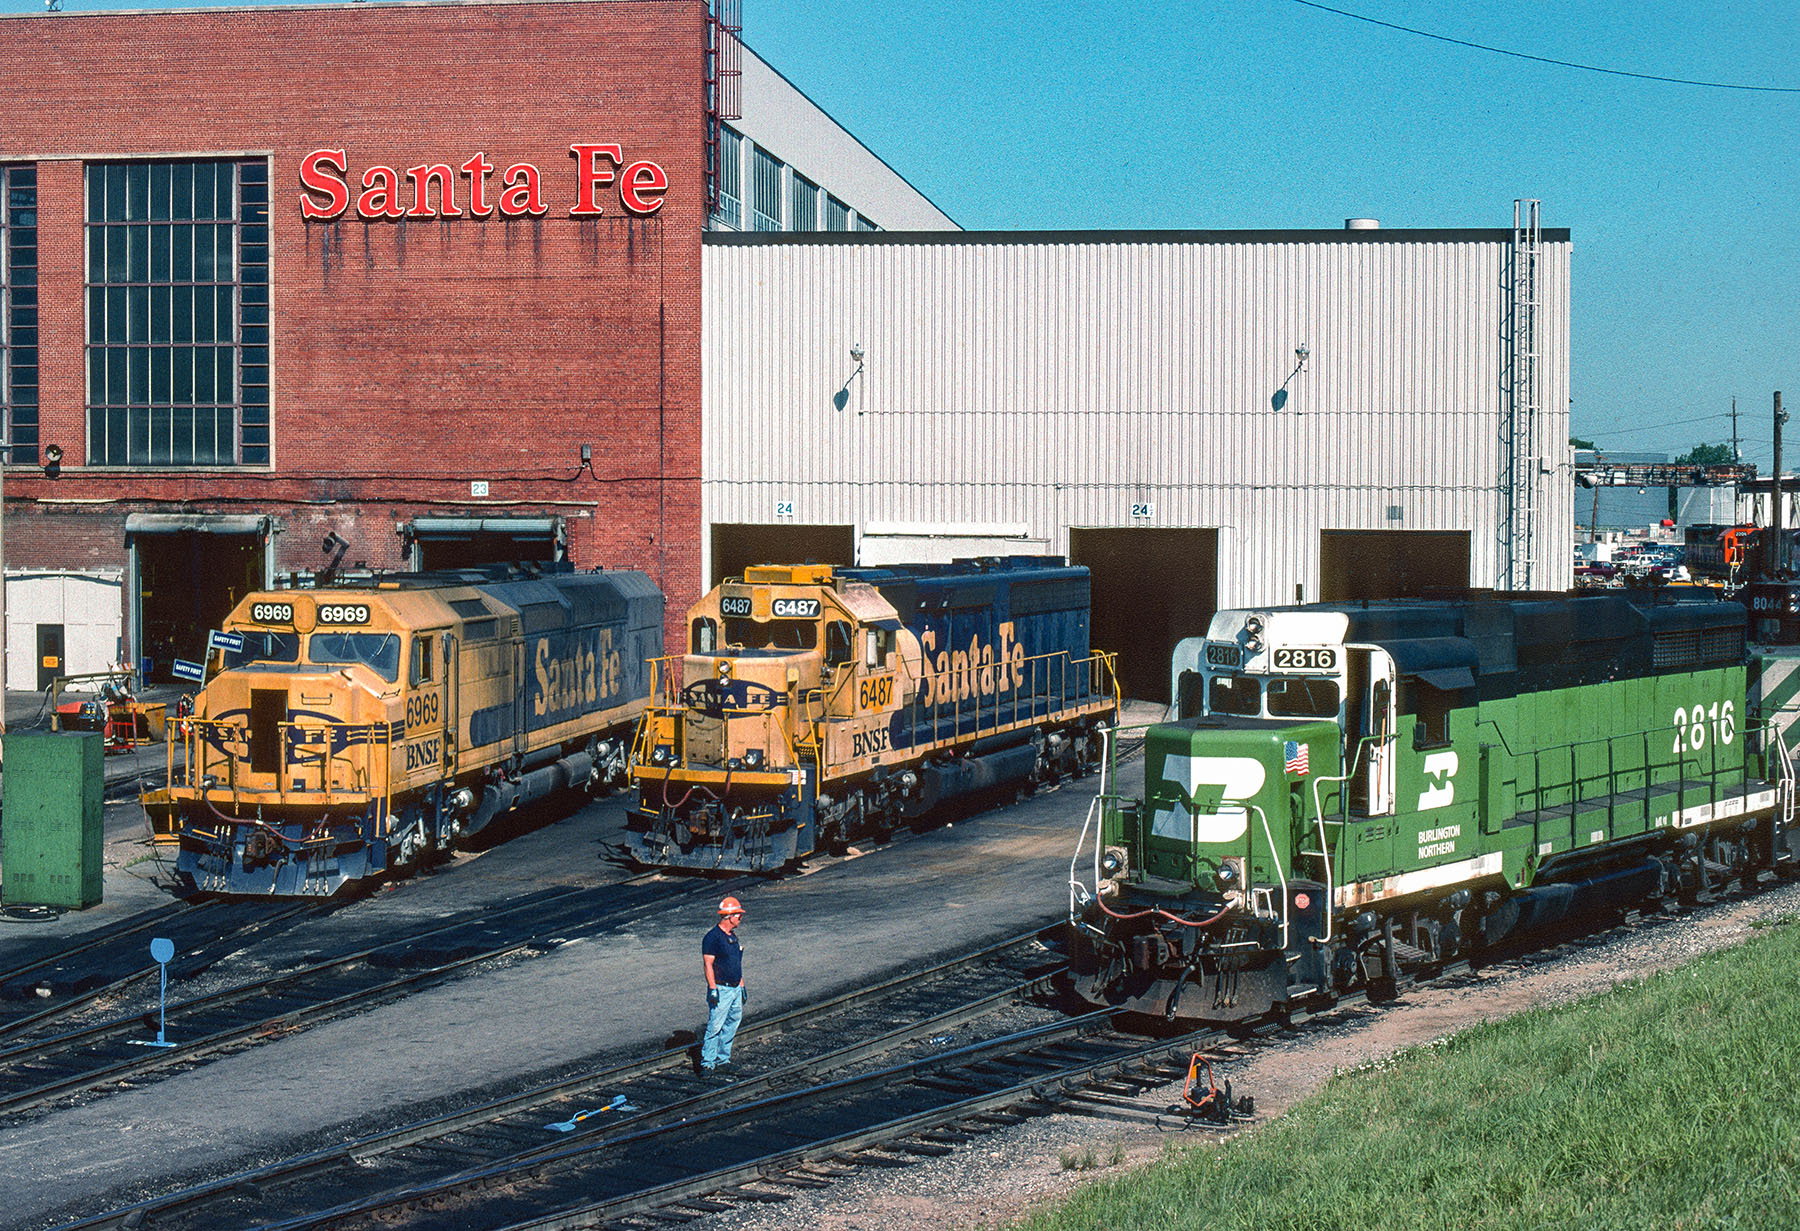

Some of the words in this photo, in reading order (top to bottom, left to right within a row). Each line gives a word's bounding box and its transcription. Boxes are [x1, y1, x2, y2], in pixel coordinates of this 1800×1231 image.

[299, 148, 548, 219] Santa
[569, 143, 669, 216] Fe
[472, 483, 487, 495] 23
[777, 502, 793, 514] 24
[1132, 504, 1148, 516] 24
[254, 604, 292, 621] 6969
[320, 606, 368, 622] 6969
[722, 598, 750, 614] 6487
[774, 599, 818, 616] 6487
[214, 635, 230, 644] SAFETY
[229, 638, 242, 646] FIRST
[1208, 646, 1238, 664] 2816
[1278, 650, 1332, 668] 2816
[175, 663, 191, 673] SAFETY
[189, 667, 202, 676] FIRST
[534, 636, 596, 717] Santa
[599, 627, 621, 700] Fe
[921, 628, 994, 709] Santa
[999, 621, 1024, 693] Fe
[746, 694, 770, 704] FE
[860, 676, 893, 710] 6487
[406, 692, 438, 729] 6969
[1672, 700, 1735, 753] 2816
[852, 726, 889, 758] BNSF
[406, 738, 440, 771] BNSF
[1418, 824, 1461, 844] BURLINGTON
[1418, 840, 1455, 860] NORTHERN
